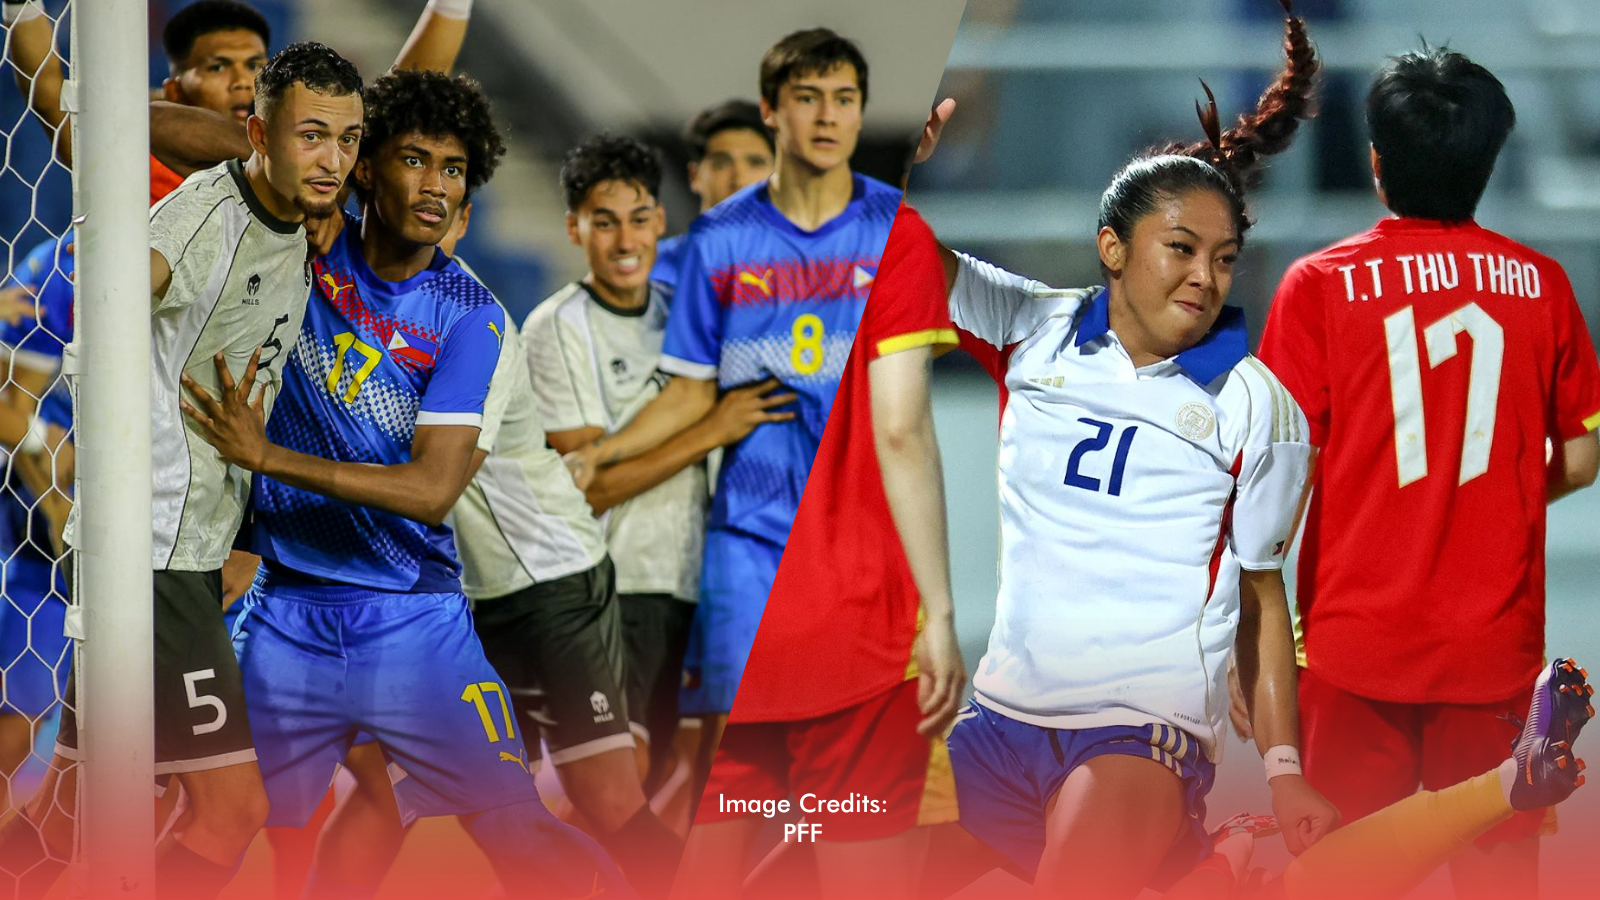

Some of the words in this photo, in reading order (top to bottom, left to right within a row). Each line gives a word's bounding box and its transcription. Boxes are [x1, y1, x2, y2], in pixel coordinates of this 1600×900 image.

[241, 298, 260, 306] MILLS
[1338, 258, 1383, 302] T.T
[1396, 252, 1459, 295] THU
[1467, 252, 1541, 299] THAO
[327, 331, 383, 404] 17
[791, 313, 825, 376] 8
[1383, 301, 1505, 489] 17
[1063, 417, 1139, 497] 21
[182, 668, 228, 736] 5
[460, 681, 515, 743] 17
